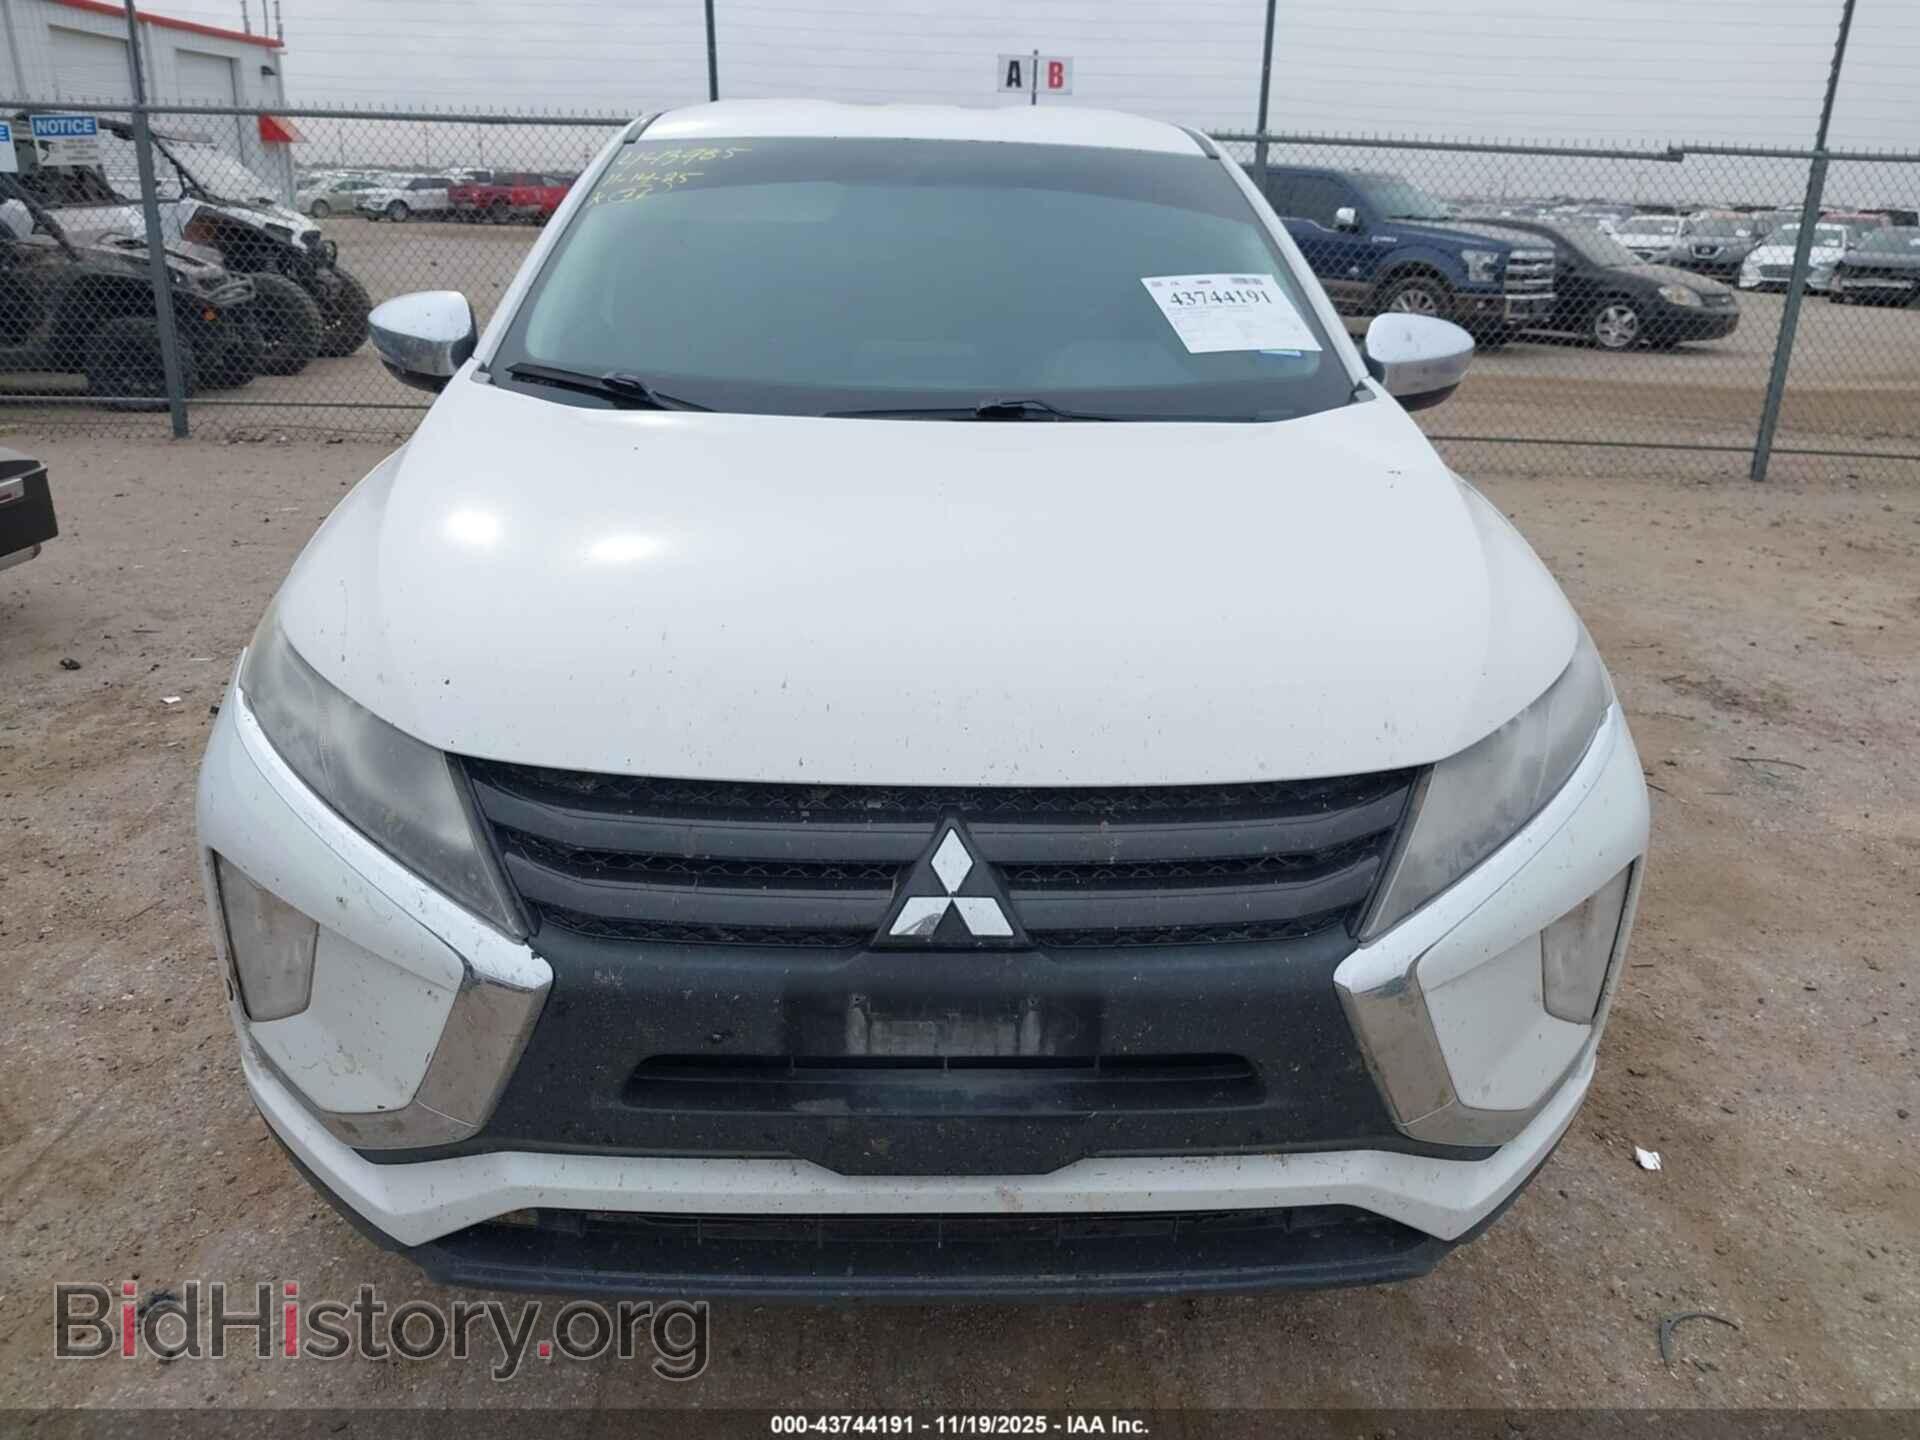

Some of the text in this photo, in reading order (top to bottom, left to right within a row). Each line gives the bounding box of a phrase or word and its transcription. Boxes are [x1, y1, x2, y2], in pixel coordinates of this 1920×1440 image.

[1006, 60, 1022, 88] A
[1048, 61, 1064, 89] B
[35, 118, 94, 134] NOTICE
[1170, 289, 1273, 306] 43744191
